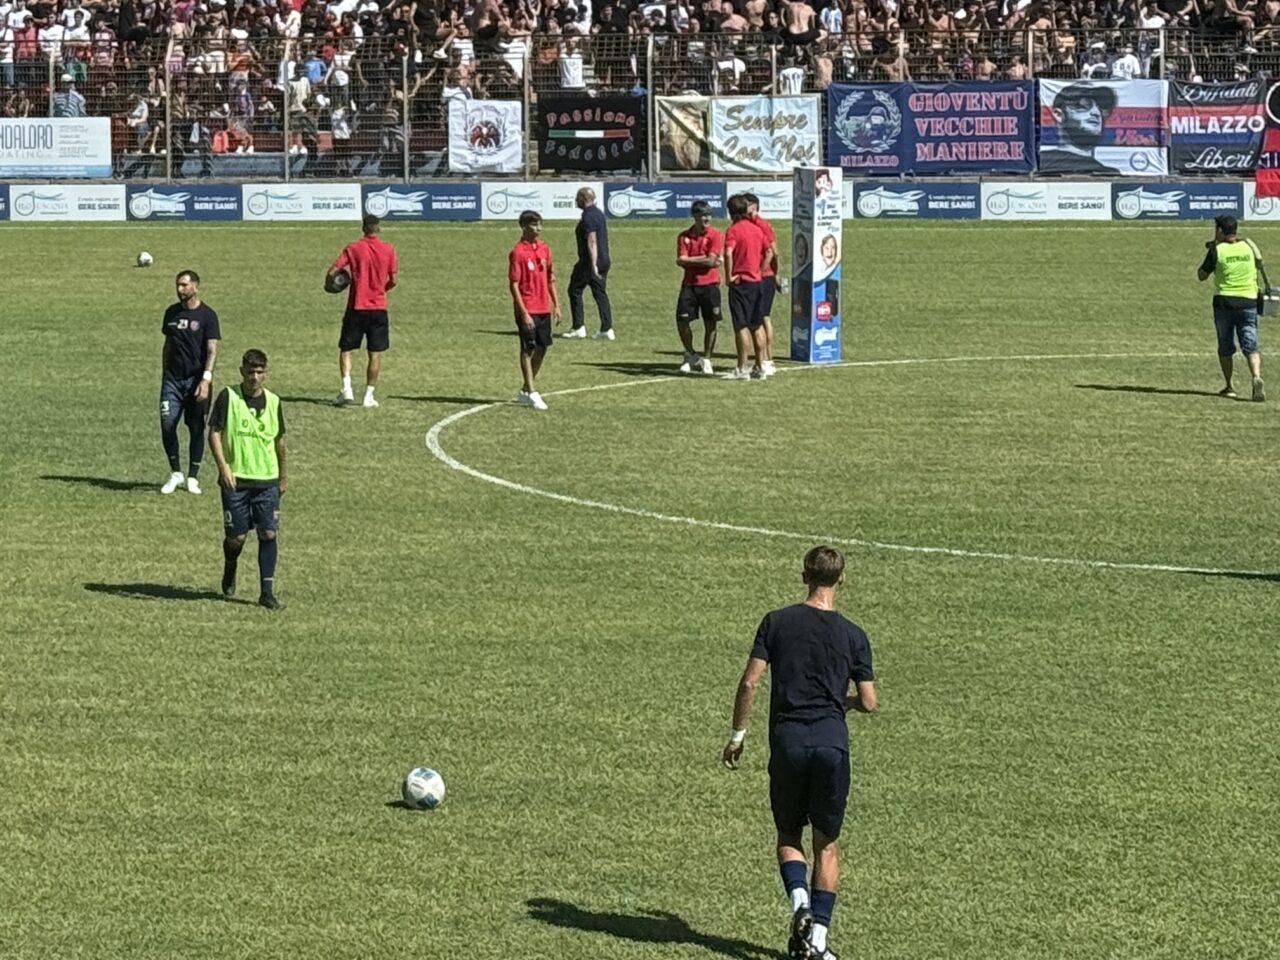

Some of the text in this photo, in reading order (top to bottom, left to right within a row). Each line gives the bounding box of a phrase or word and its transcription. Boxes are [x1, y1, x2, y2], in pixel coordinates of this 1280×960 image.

[908, 87, 1029, 112] GIOVENTÙ
[722, 104, 809, 137] Sempre
[914, 116, 1019, 137] VECCHIE
[1171, 115, 1265, 135] MILAZZO
[722, 135, 816, 163] Con Noi
[915, 141, 1025, 162] MANIERE
[1184, 146, 1254, 169] Liberi
[840, 155, 900, 167] MILAZZO
[432, 202, 451, 210] BERE
[928, 201, 950, 209] BERE
[1058, 202, 1078, 210] BERE
[1189, 201, 1211, 210] BERE
[177, 318, 188, 329] 23
